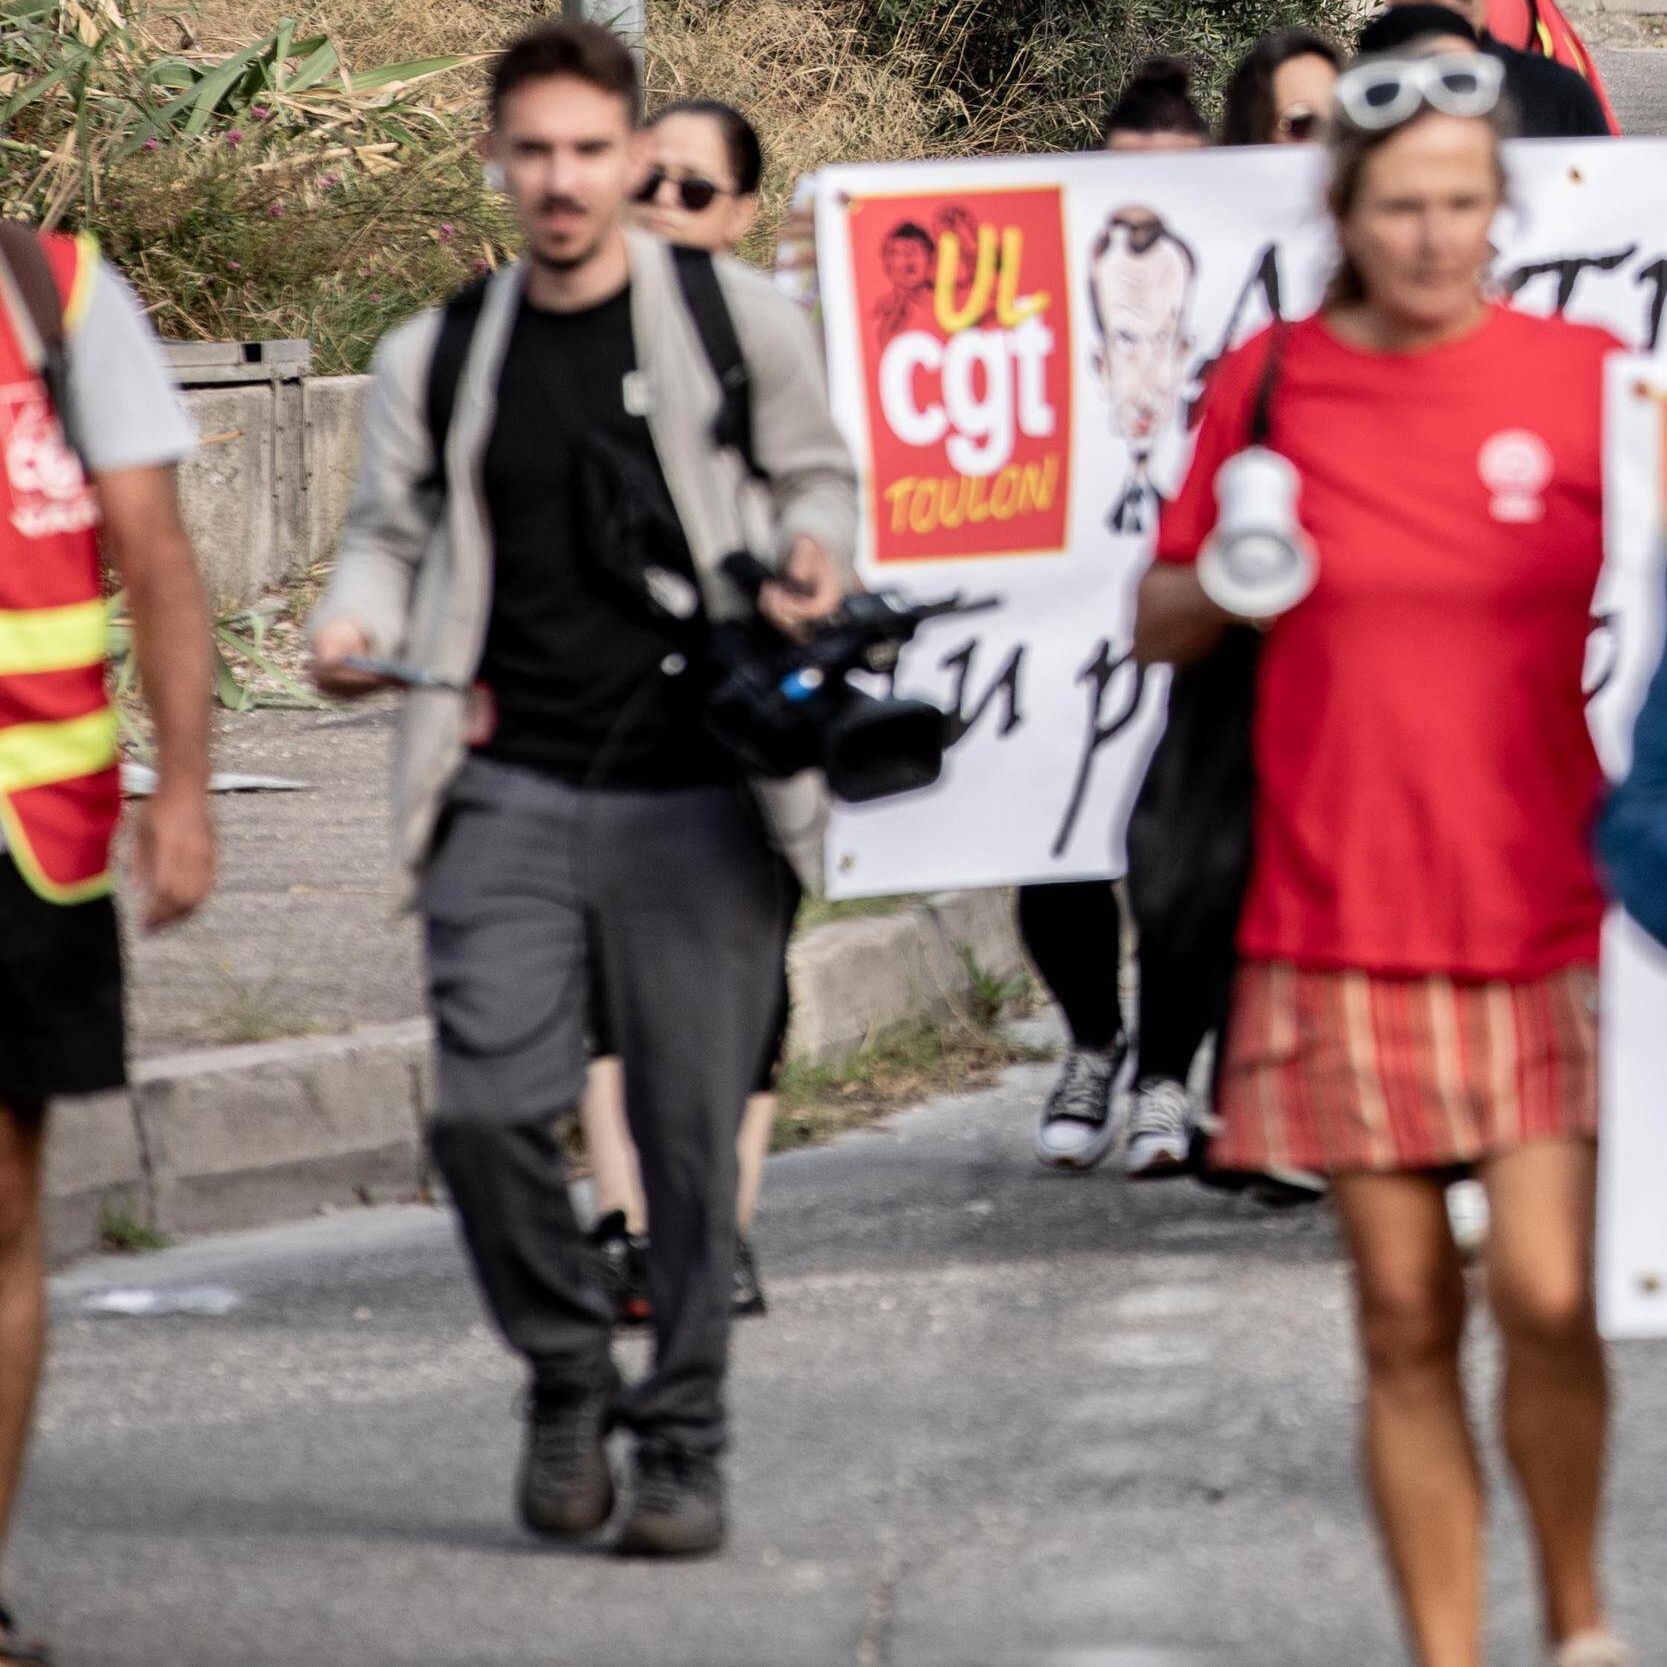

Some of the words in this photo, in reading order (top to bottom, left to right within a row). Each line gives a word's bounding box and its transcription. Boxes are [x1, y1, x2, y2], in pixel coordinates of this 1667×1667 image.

[934, 226, 1051, 332] UL
[879, 314, 1055, 476] cgt
[884, 455, 1060, 535] TOULON
